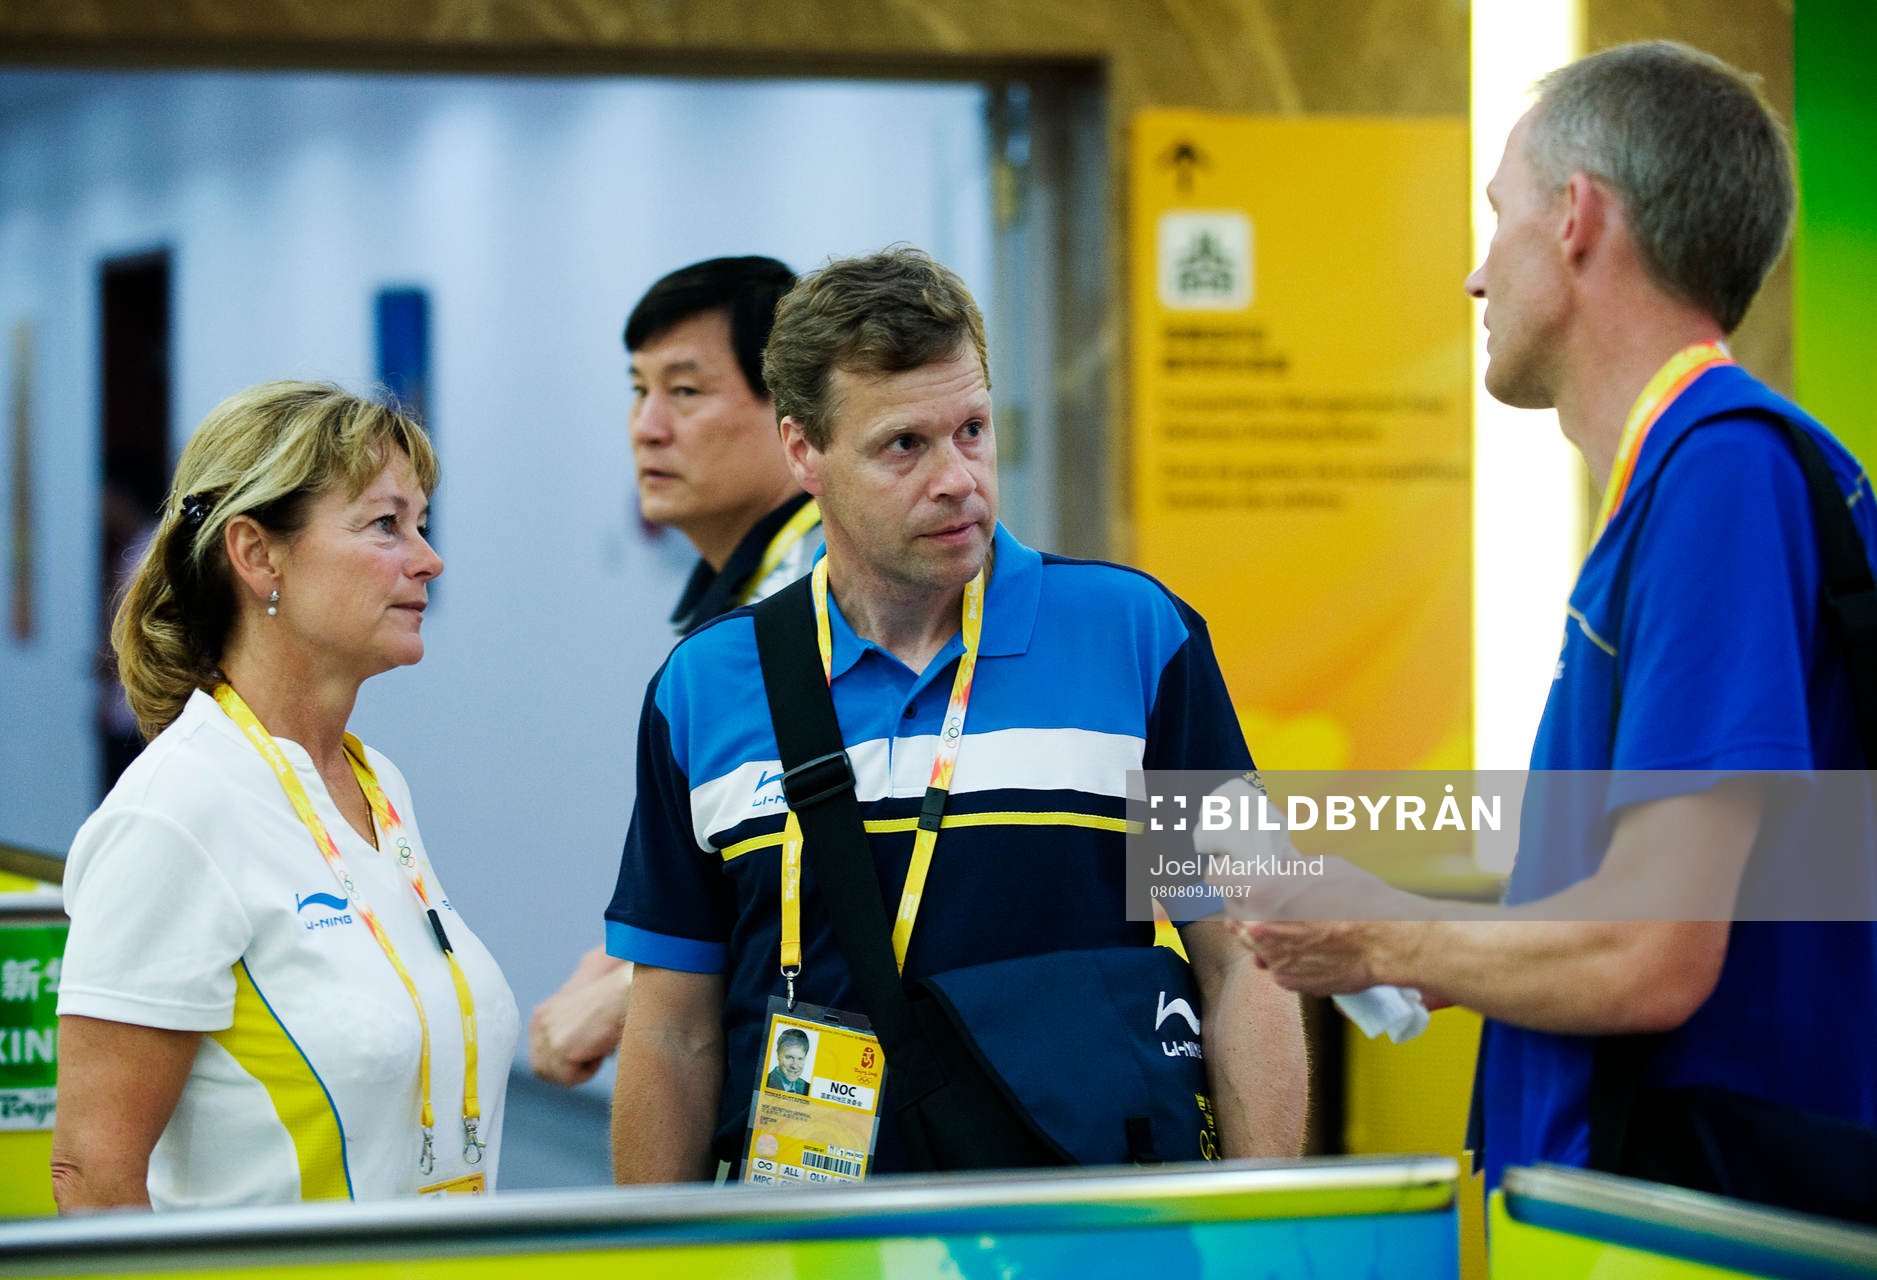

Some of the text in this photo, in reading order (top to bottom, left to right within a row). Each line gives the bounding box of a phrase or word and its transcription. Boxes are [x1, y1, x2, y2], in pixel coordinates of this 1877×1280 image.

[752, 794, 788, 807] LI-N
[830, 1081, 857, 1098] NOC
[783, 1166, 799, 1178] ALL
